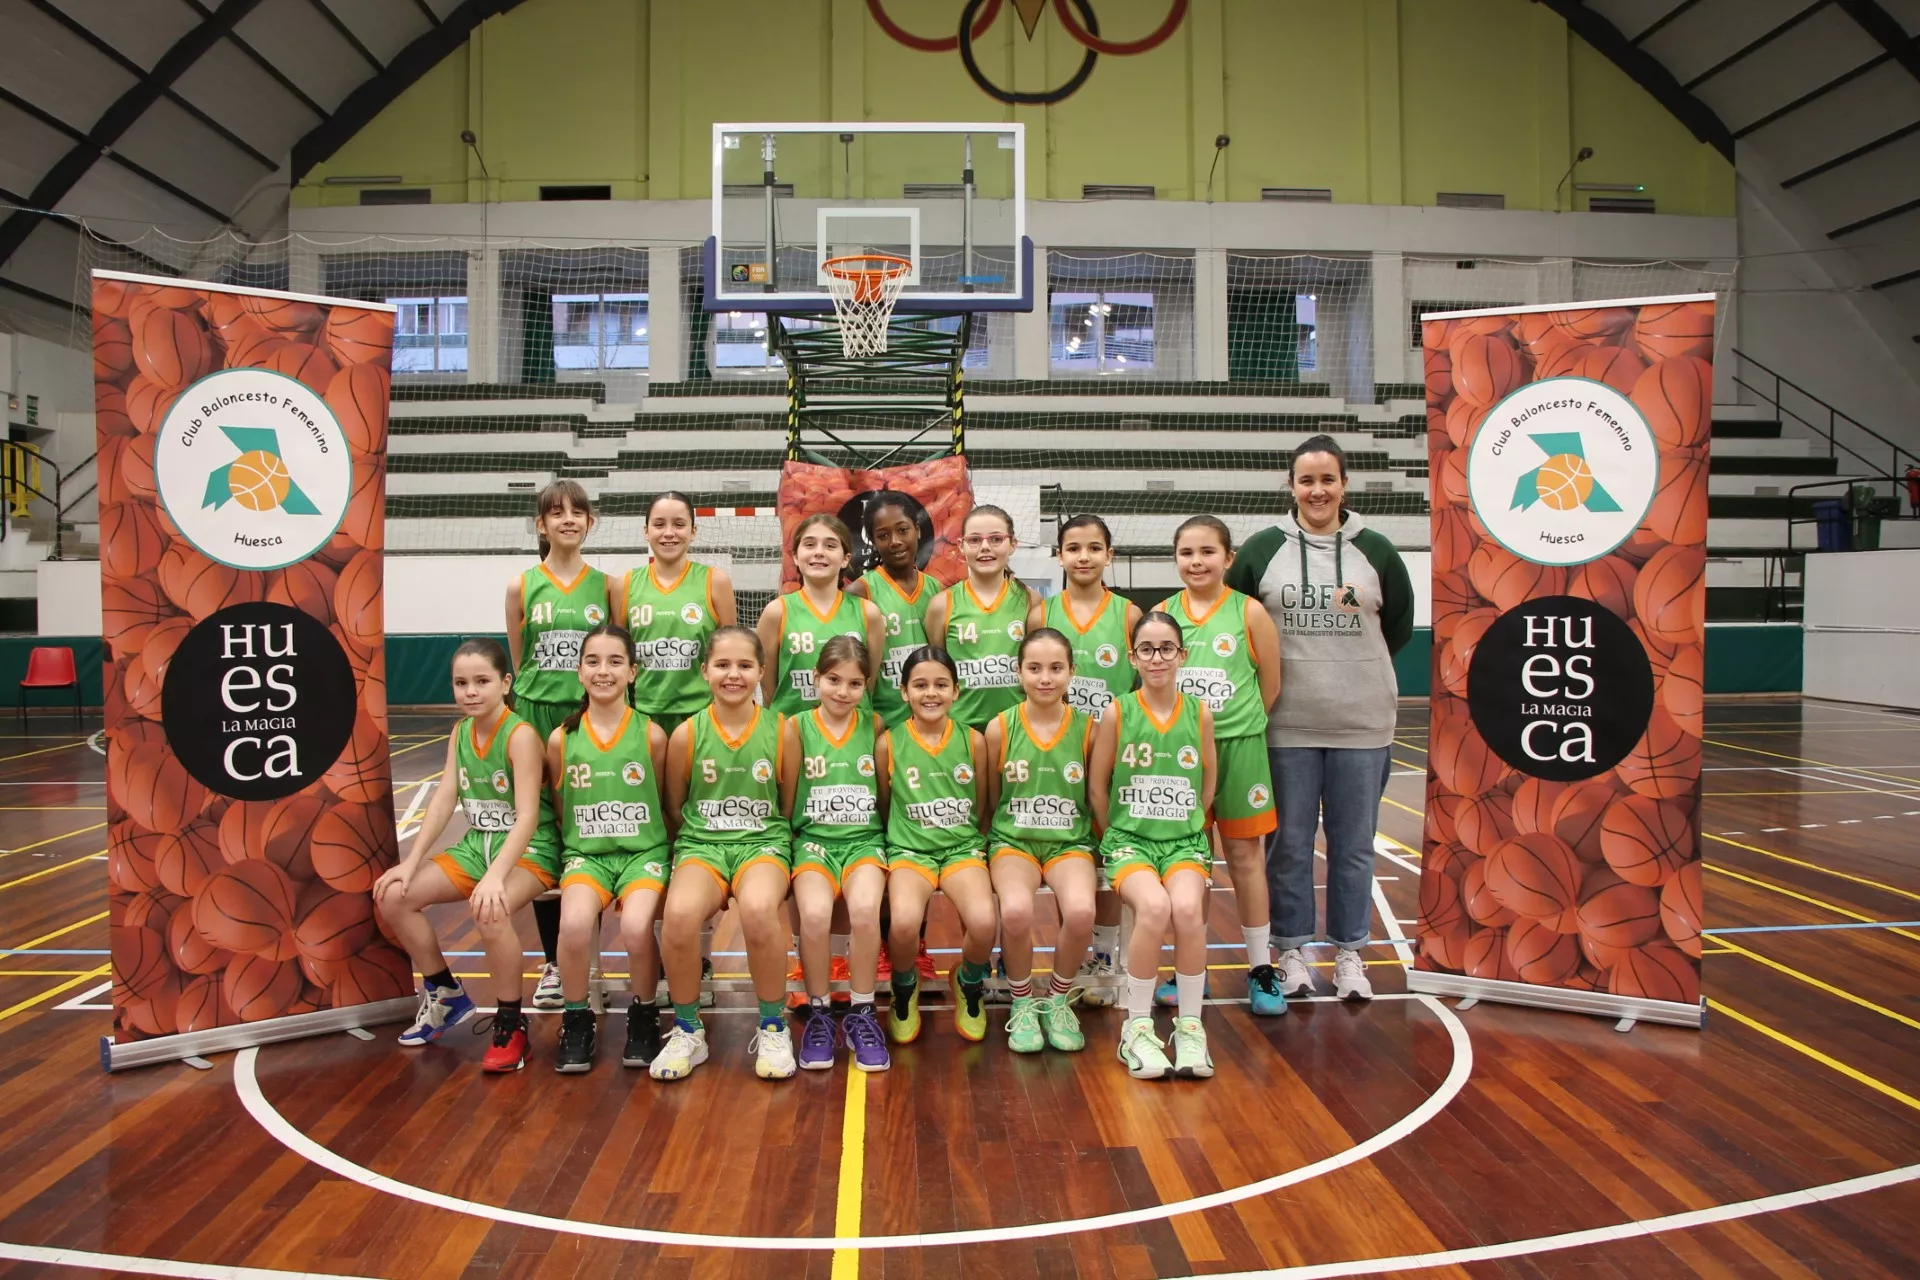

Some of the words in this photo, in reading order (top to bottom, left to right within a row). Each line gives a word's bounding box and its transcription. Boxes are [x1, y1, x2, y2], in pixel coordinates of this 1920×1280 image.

[181, 417, 203, 447] Club
[201, 392, 278, 417] Baloncesto
[282, 398, 329, 454] Femenino
[1491, 428, 1512, 456] Club
[1511, 398, 1582, 428] Baloncesto
[1586, 401, 1632, 452] Femenino
[233, 532, 283, 547] Huesca
[1539, 530, 1585, 544] Huesca
[1281, 583, 1335, 611] CBF
[531, 601, 552, 625] 41
[629, 604, 653, 629] 20
[881, 612, 901, 637] 3
[1282, 612, 1362, 629] HUESCA
[220, 623, 298, 659] Hu
[788, 631, 815, 655] 38
[955, 622, 978, 645] 14
[1522, 615, 1595, 649] Hu
[534, 640, 579, 659] Hues
[958, 657, 1018, 677] Huesc
[1521, 653, 1595, 700] es
[221, 663, 297, 713] es
[1068, 687, 1113, 708] esca
[1176, 678, 1232, 698] esca
[1521, 703, 1539, 715] La
[222, 720, 241, 733] La
[1520, 720, 1596, 763] ca
[223, 734, 303, 781] ca
[804, 755, 827, 779] 30
[1121, 742, 1153, 768] 43
[566, 763, 592, 788] 32
[701, 759, 718, 783] 5
[906, 766, 921, 789] 2
[1004, 759, 1030, 783] 26
[804, 794, 876, 813] Huesca
[1122, 786, 1196, 807] Huesca
[575, 803, 648, 823] Huesca
